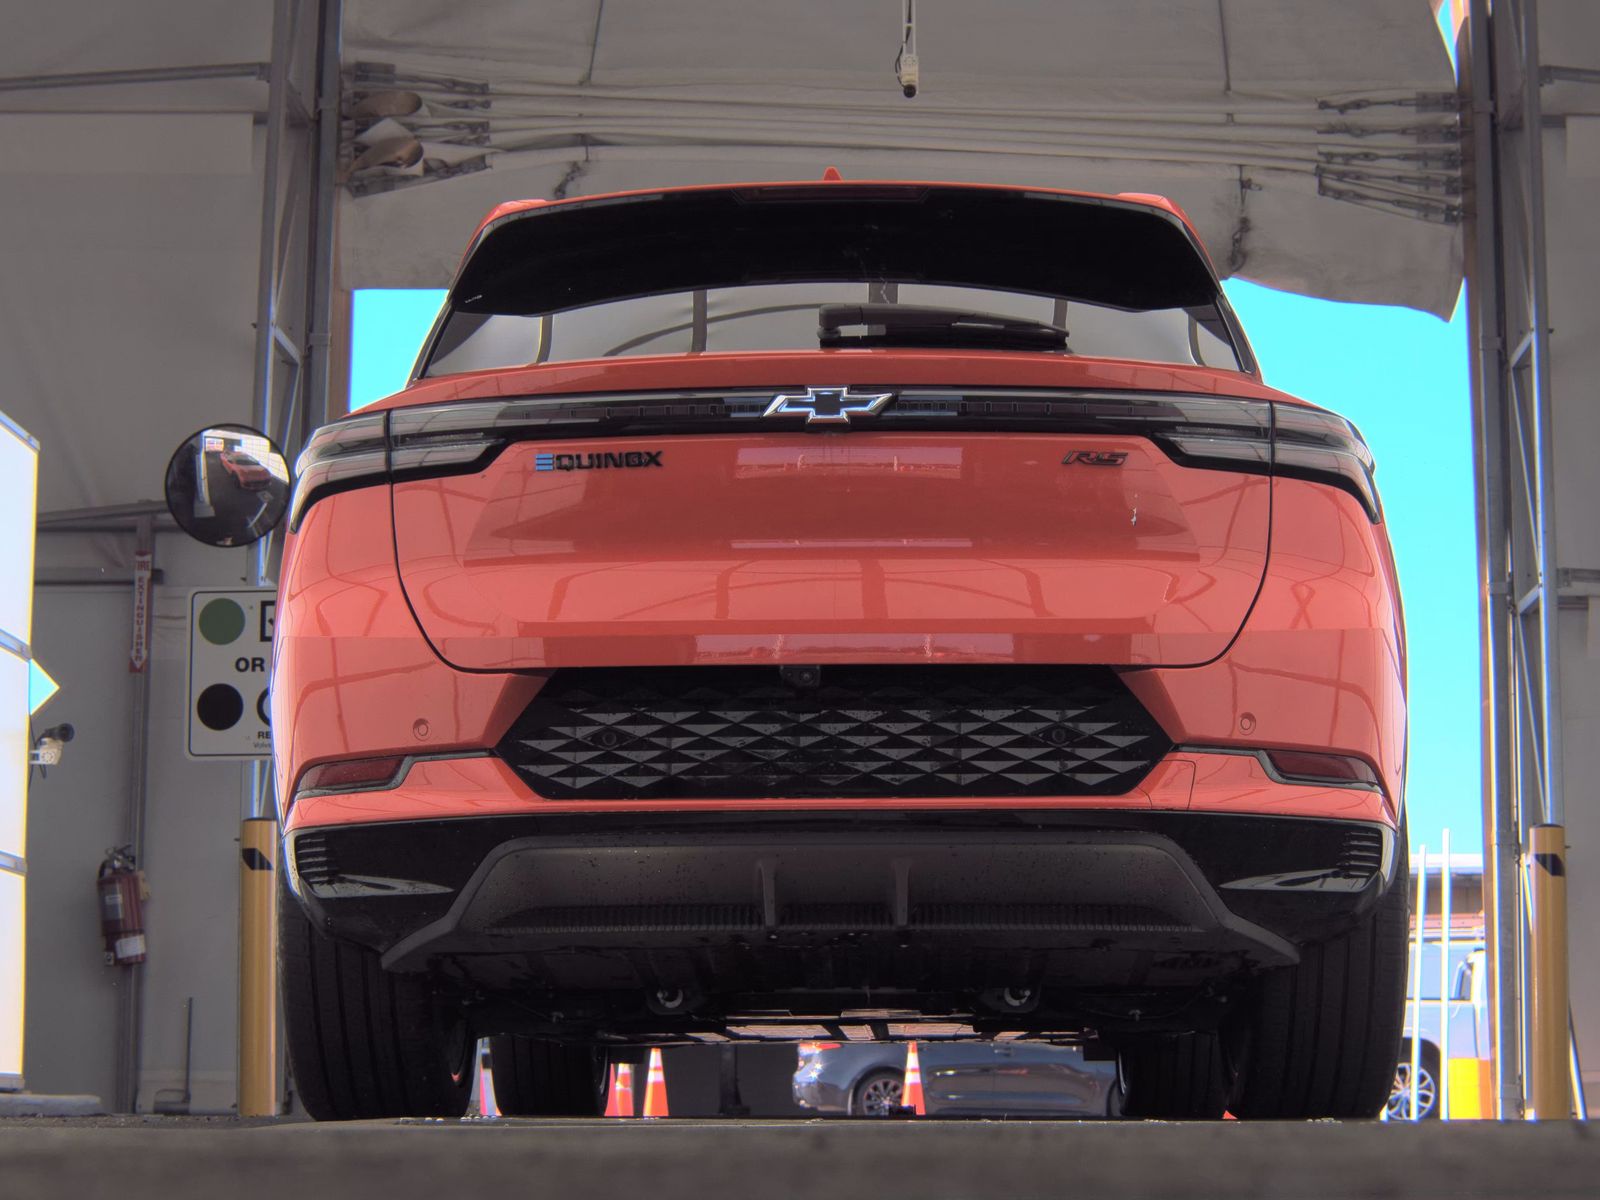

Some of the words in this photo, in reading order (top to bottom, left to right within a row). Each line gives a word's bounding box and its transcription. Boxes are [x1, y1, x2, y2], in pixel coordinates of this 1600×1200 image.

[535, 451, 663, 471] EQUINOX
[1061, 449, 1129, 466] RS
[235, 657, 265, 672] OR
